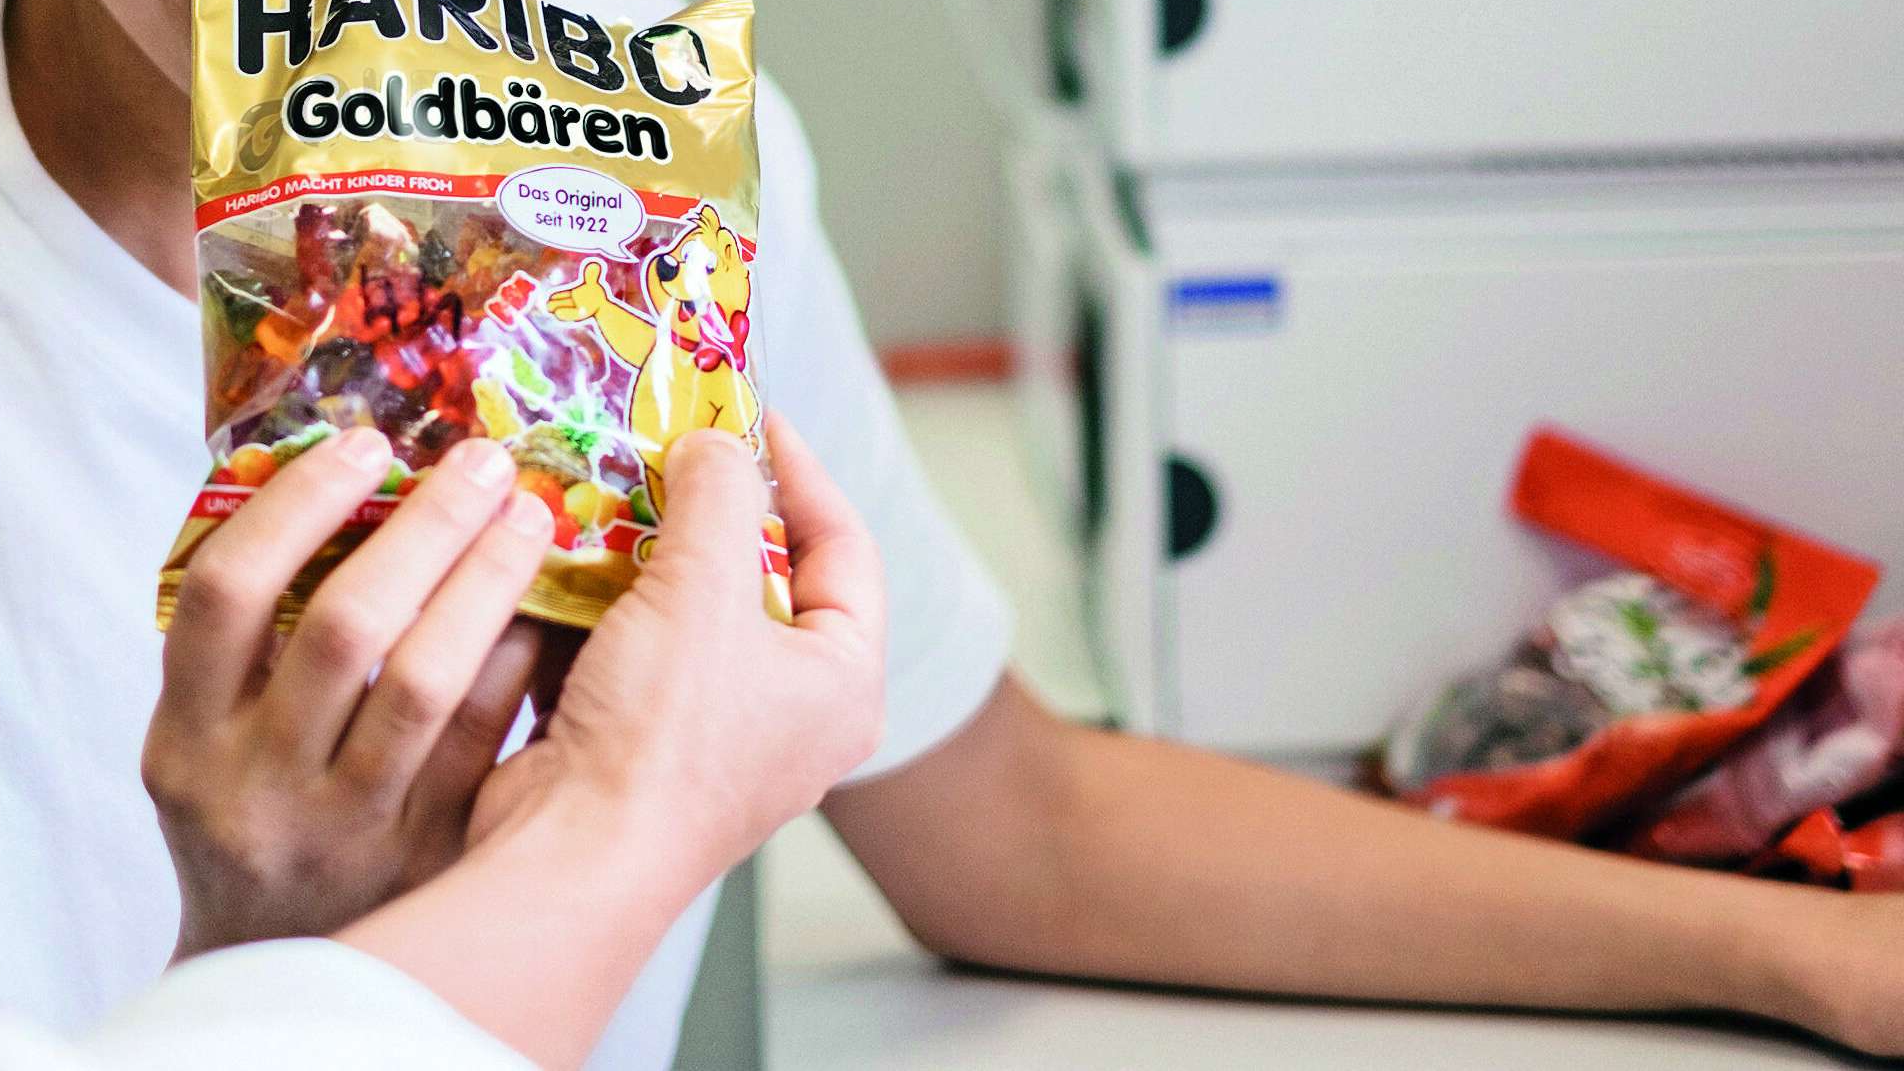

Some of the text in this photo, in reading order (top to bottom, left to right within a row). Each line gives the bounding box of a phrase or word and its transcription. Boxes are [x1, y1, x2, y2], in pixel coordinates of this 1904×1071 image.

[287, 76, 670, 160] Goldbären
[225, 174, 453, 212] HARIBO MACHT KINDER FROH
[518, 184, 622, 212] Das Original
[536, 211, 608, 233] seit 1922
